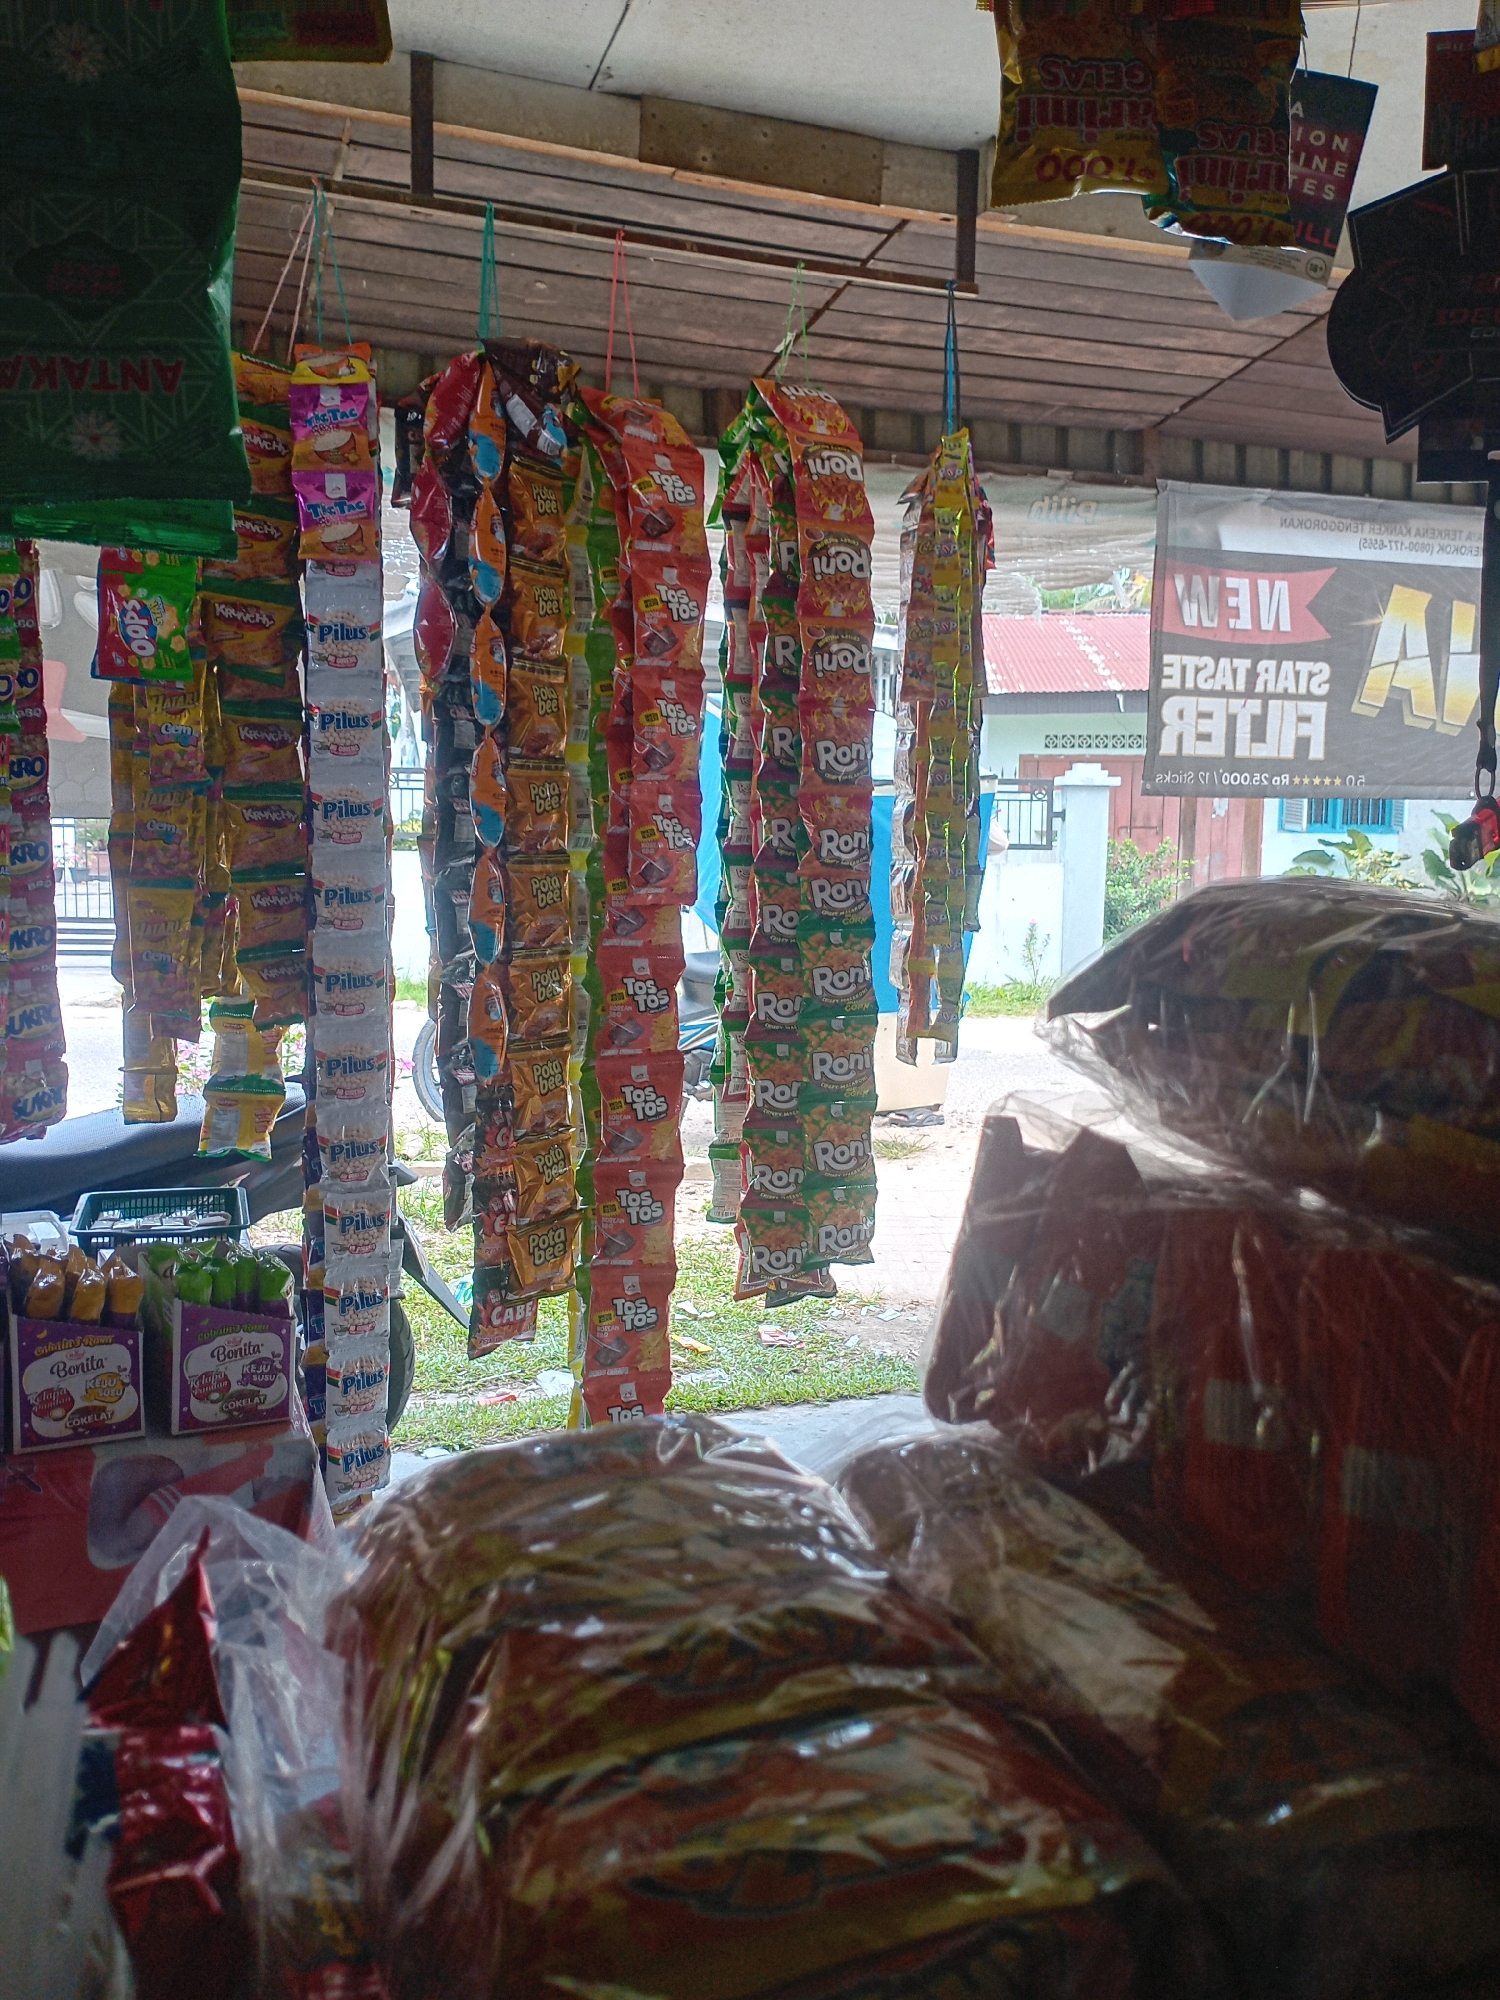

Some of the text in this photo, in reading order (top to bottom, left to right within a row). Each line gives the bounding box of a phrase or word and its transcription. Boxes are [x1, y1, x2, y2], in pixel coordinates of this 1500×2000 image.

[1039, 57, 1152, 93] GELAS
[1015, 95, 1160, 146] arimi
[1289, 150, 1348, 178] INE
[806, 449, 864, 482] Roni
[531, 483, 556, 500] Pota
[536, 494, 558, 515] bee
[814, 545, 872, 582] Roni
[532, 585, 557, 602] Pota
[538, 597, 560, 617] bee
[318, 622, 368, 644] Pilus
[814, 642, 872, 679] Roni
[531, 683, 558, 702] Pota
[538, 696, 560, 716] bee
[320, 711, 370, 732] Pilus
[815, 735, 872, 772] Roni
[529, 780, 560, 803] Pota
[322, 799, 372, 820] Pilus
[535, 795, 561, 814] bee
[530, 873, 561, 897] Pota
[324, 886, 373, 908] Pilus
[537, 887, 562, 909] bee
[325, 972, 374, 994] Pilus
[532, 967, 560, 990] Pota
[536, 980, 562, 1002] bee
[325, 1054, 377, 1077] Pilus
[532, 1059, 562, 1079] Pota
[811, 1045, 872, 1082] Roni
[539, 1073, 564, 1096] bee
[329, 1139, 378, 1162] Pilus
[536, 1146, 564, 1170] Pota
[813, 1131, 871, 1172] Roni
[544, 1159, 566, 1185] bee
[340, 1211, 386, 1236] Pilus
[528, 1225, 566, 1253] Pota
[533, 1242, 566, 1267] bee
[750, 1240, 809, 1279] Roni
[340, 1290, 384, 1317] Pilus
[490, 1300, 534, 1327] CABE
[210, 1341, 262, 1362] Bonita
[50, 1355, 105, 1378] Bonita
[242, 1363, 271, 1374] KEJU
[86, 1378, 117, 1389] KEJU
[341, 1369, 385, 1397] Pilus
[221, 1395, 267, 1412] COKELAT
[65, 1410, 114, 1428] COKELAT
[342, 1444, 386, 1475] Pilus
